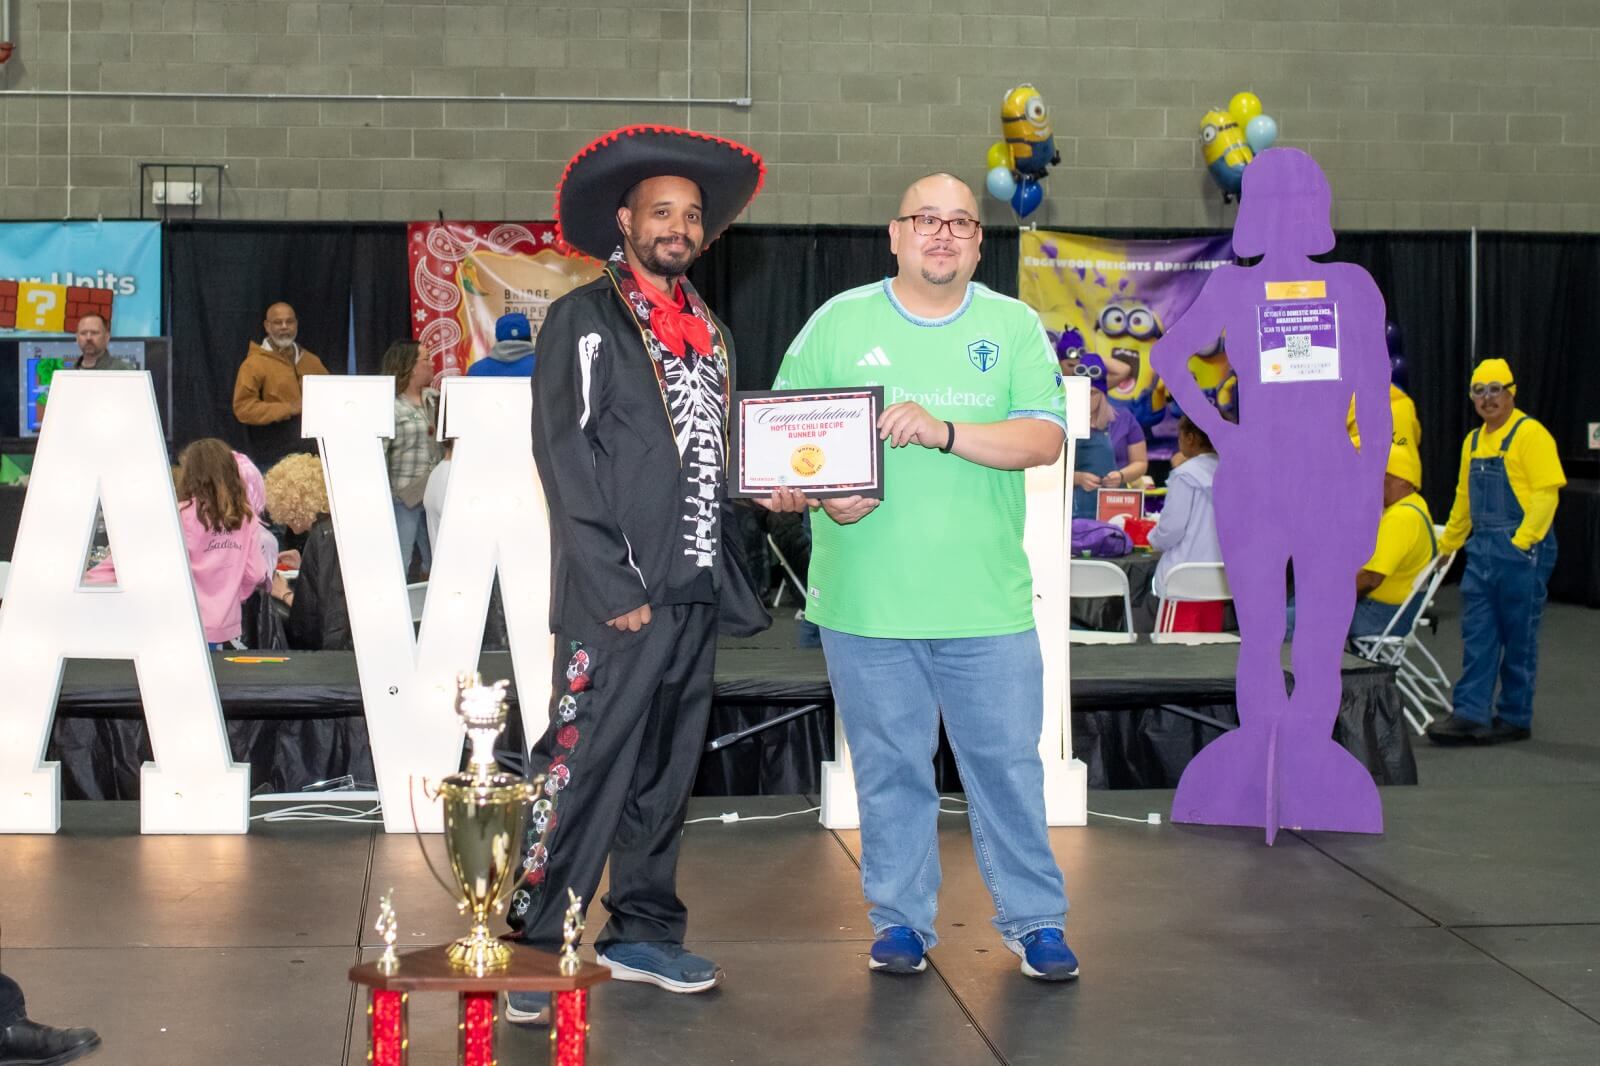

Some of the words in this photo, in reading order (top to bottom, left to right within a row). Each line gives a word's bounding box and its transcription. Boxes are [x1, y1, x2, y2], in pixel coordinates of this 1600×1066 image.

[1024, 256, 1092, 269] EDGEWOOD
[1096, 259, 1151, 270] HEIGHTS
[52, 270, 136, 295] Units
[891, 386, 996, 407] Providence
[753, 406, 864, 427] Congratulations
[770, 422, 800, 432] HOTTEST
[801, 421, 819, 430] CHILI
[820, 421, 844, 430] RECIPE
[788, 430, 816, 439] RUNNER
[817, 430, 827, 438] UP
[1106, 495, 1123, 504] THANK
[1124, 495, 1135, 504] YOU
